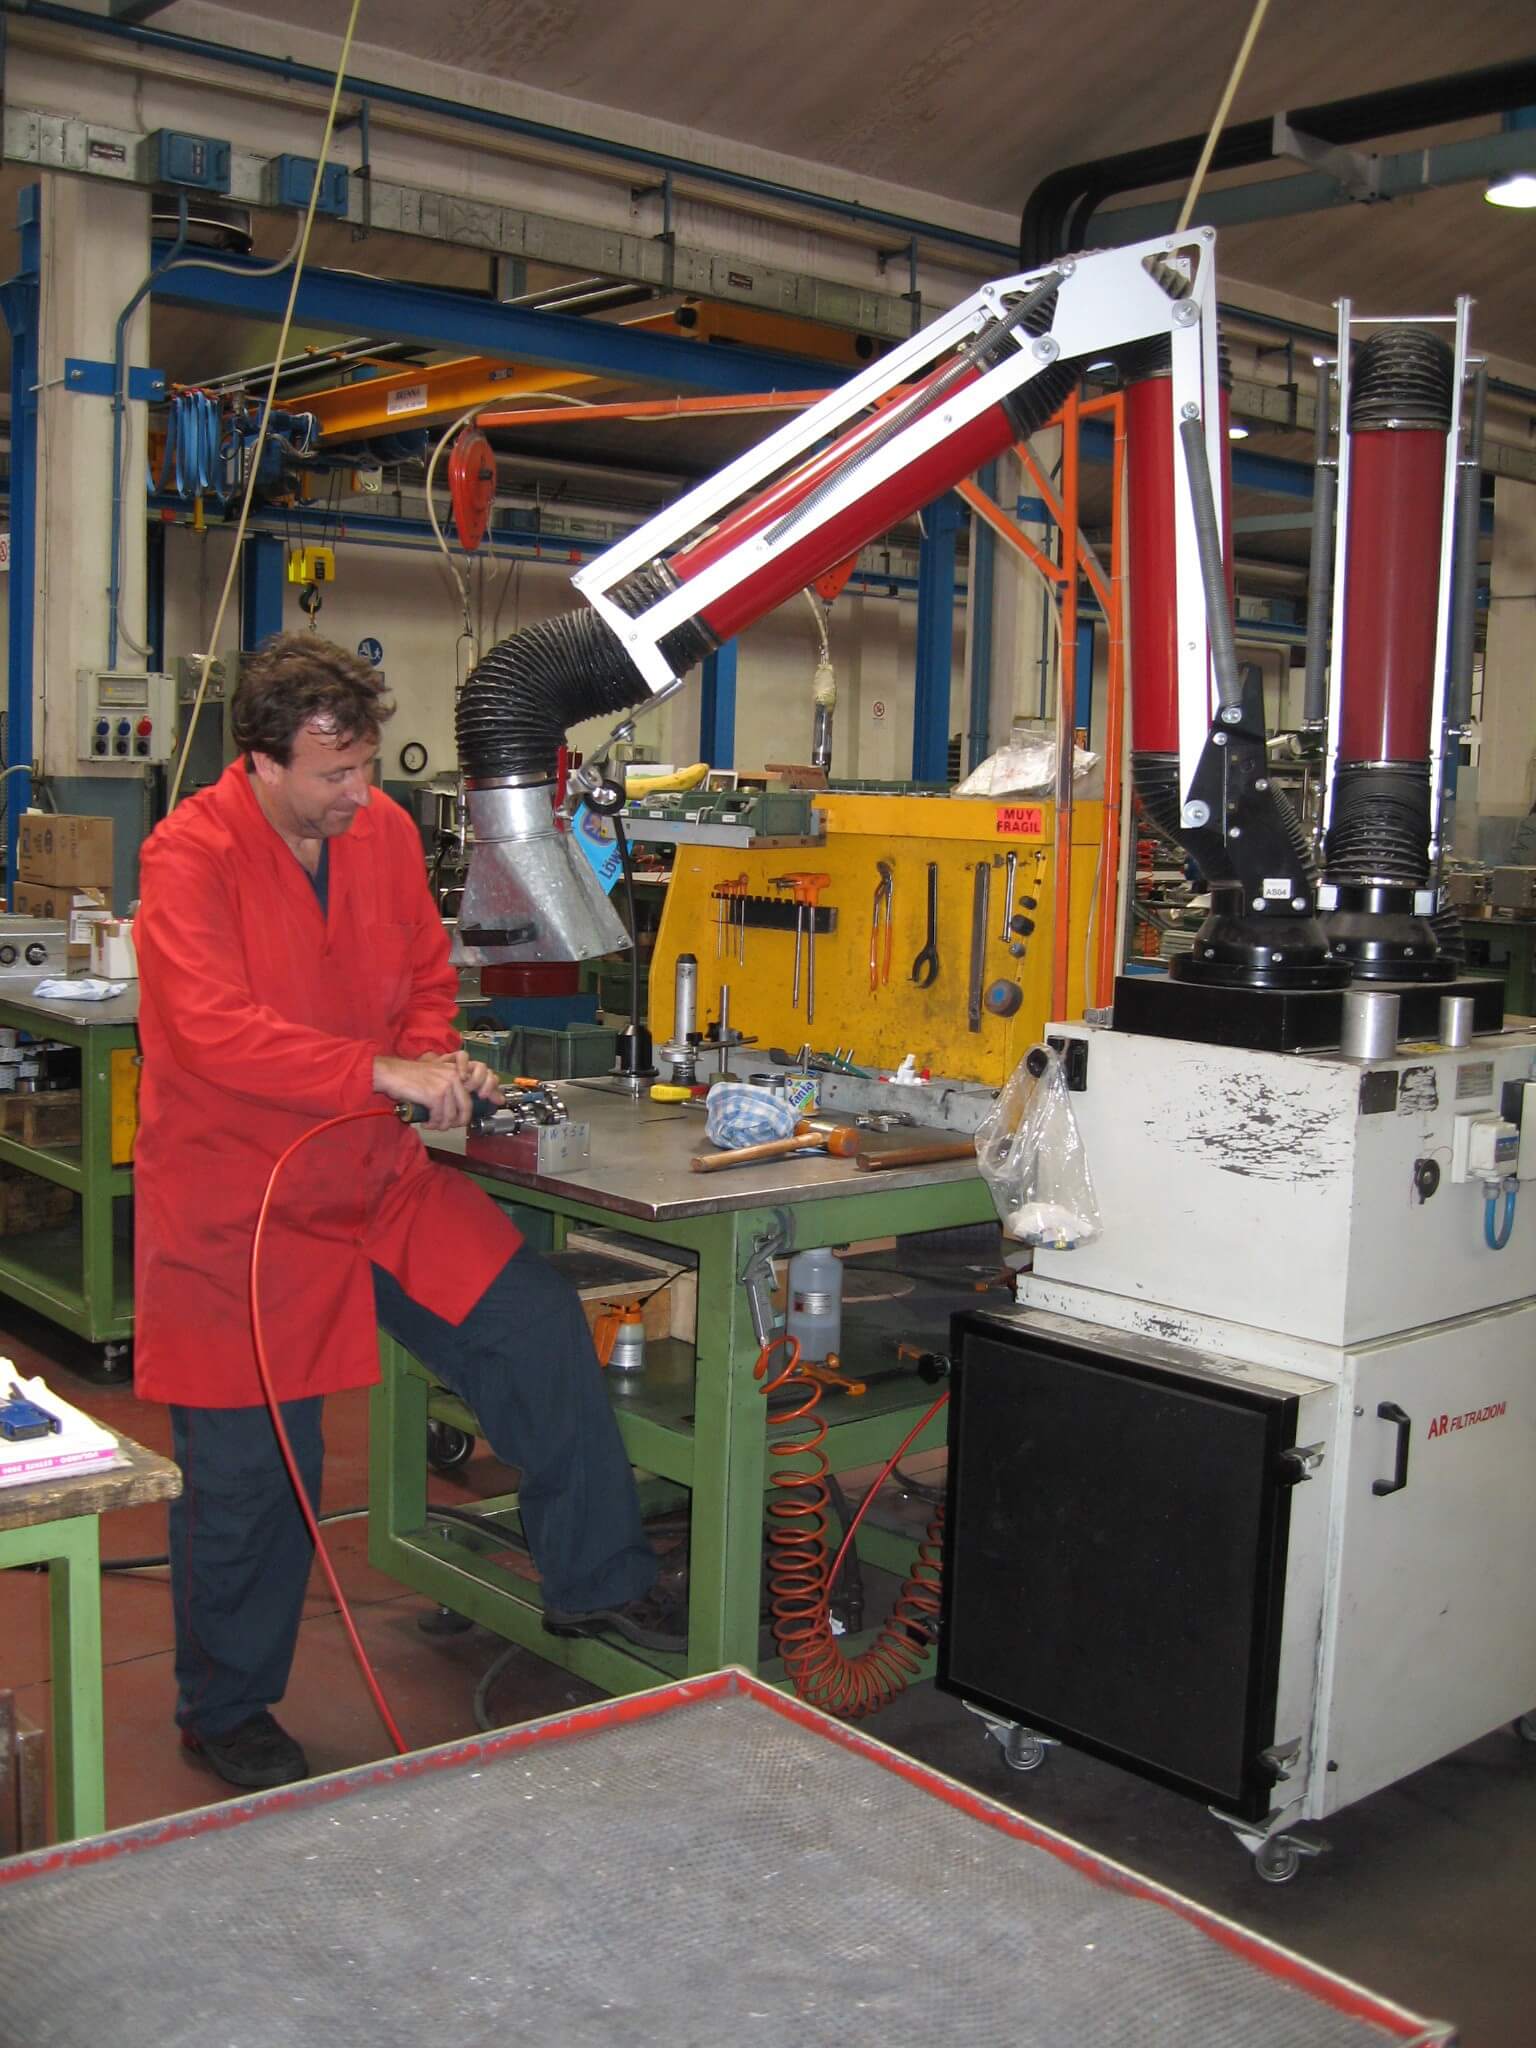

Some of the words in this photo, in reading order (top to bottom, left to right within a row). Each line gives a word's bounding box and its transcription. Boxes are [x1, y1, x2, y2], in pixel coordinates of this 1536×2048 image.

[1004, 809, 1034, 820] MUY
[996, 820, 1041, 832] FRAGIL
[1428, 1414, 1449, 1440] AR
[1450, 1401, 1506, 1432] FILTRAZIONI
